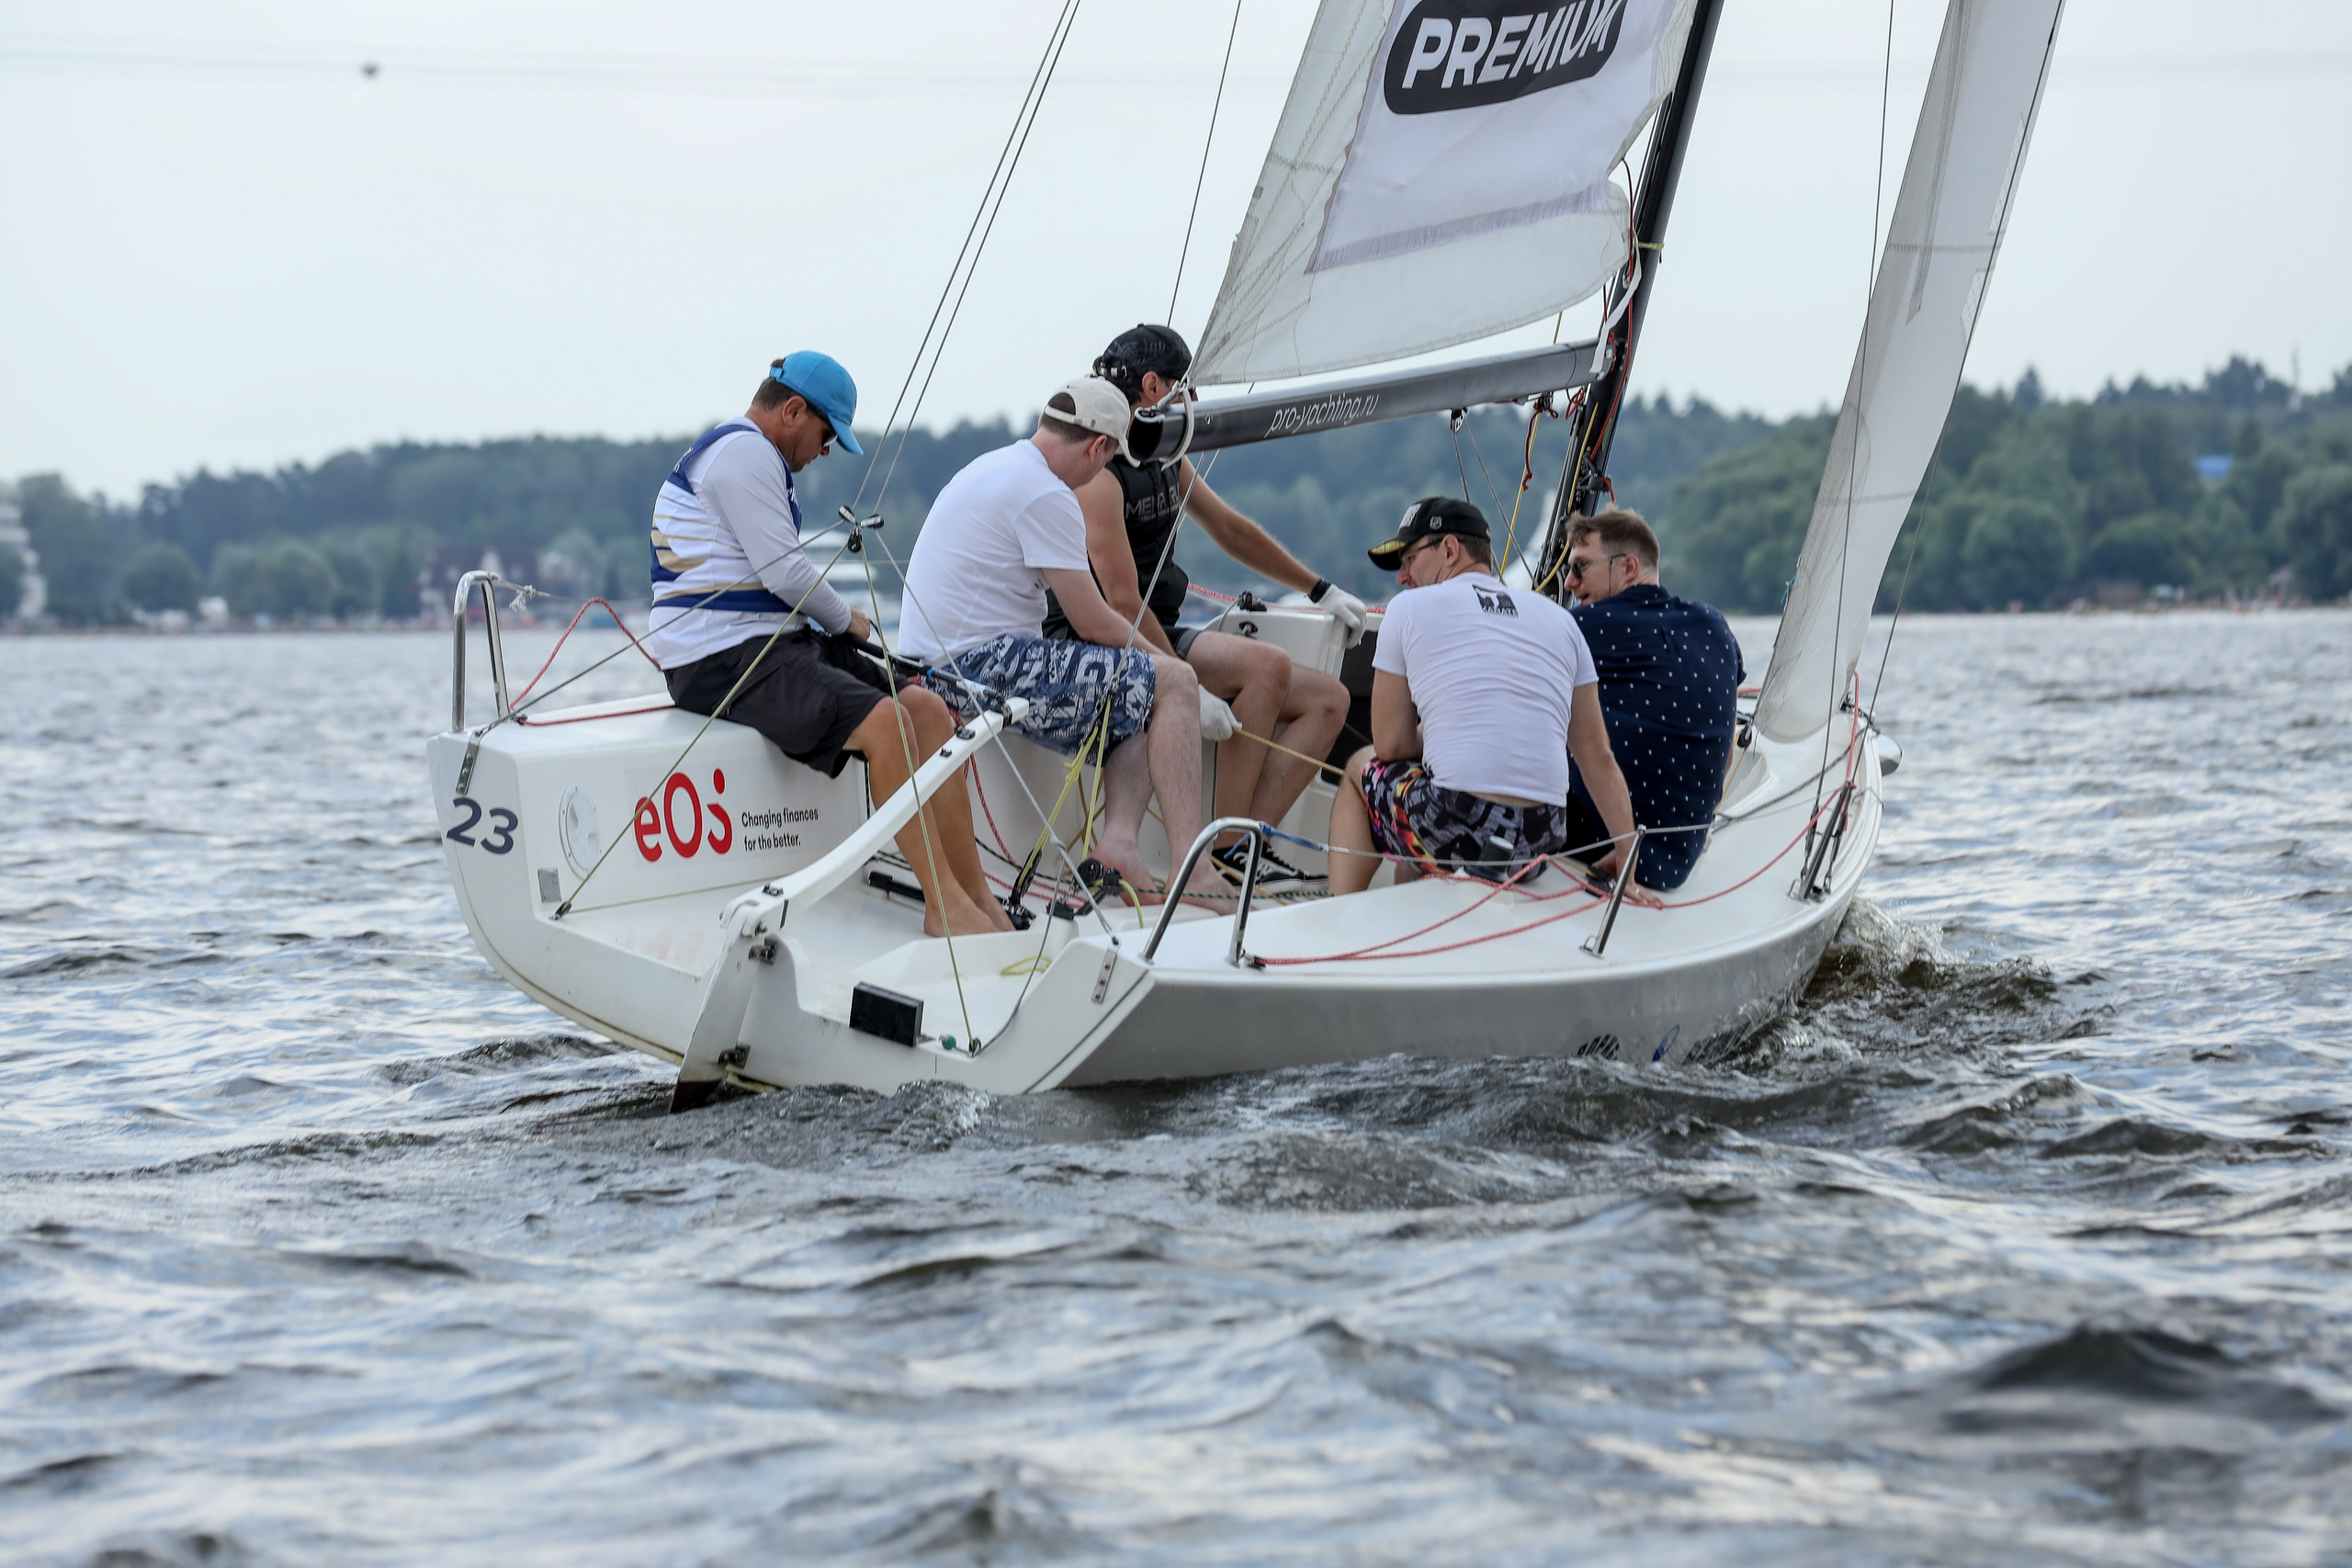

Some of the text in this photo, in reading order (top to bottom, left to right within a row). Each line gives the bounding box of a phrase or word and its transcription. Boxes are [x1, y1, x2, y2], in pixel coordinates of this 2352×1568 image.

[1401, 0, 1623, 89] PREMIUM
[1264, 392, 1379, 439] pro-yachting.ru
[447, 797, 518, 854] 23
[741, 807, 819, 829] Changing finances
[744, 832, 801, 852] for the better.
